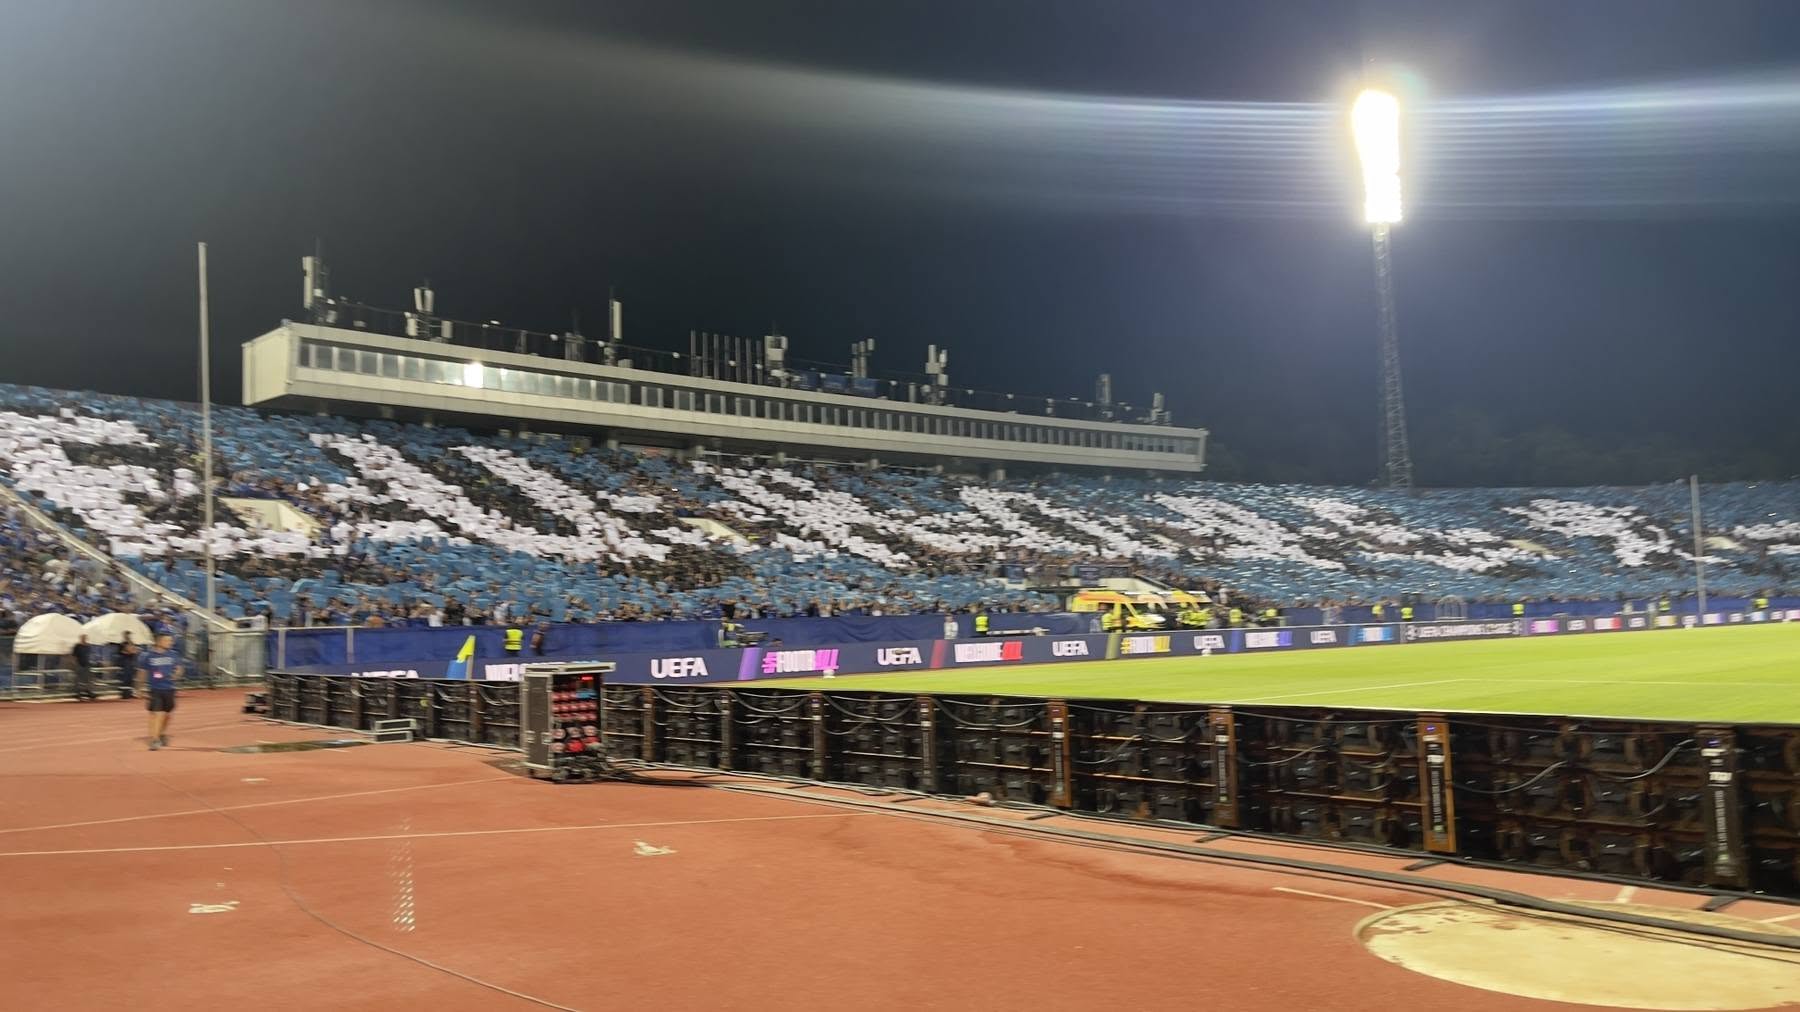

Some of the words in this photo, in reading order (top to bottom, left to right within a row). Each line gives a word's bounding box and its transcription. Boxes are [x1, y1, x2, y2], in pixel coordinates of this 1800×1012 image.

[1052, 640, 1089, 657] UEFA
[1193, 635, 1225, 650] UEFA
[877, 647, 922, 666] UEFA
[650, 656, 708, 679] UEFA
